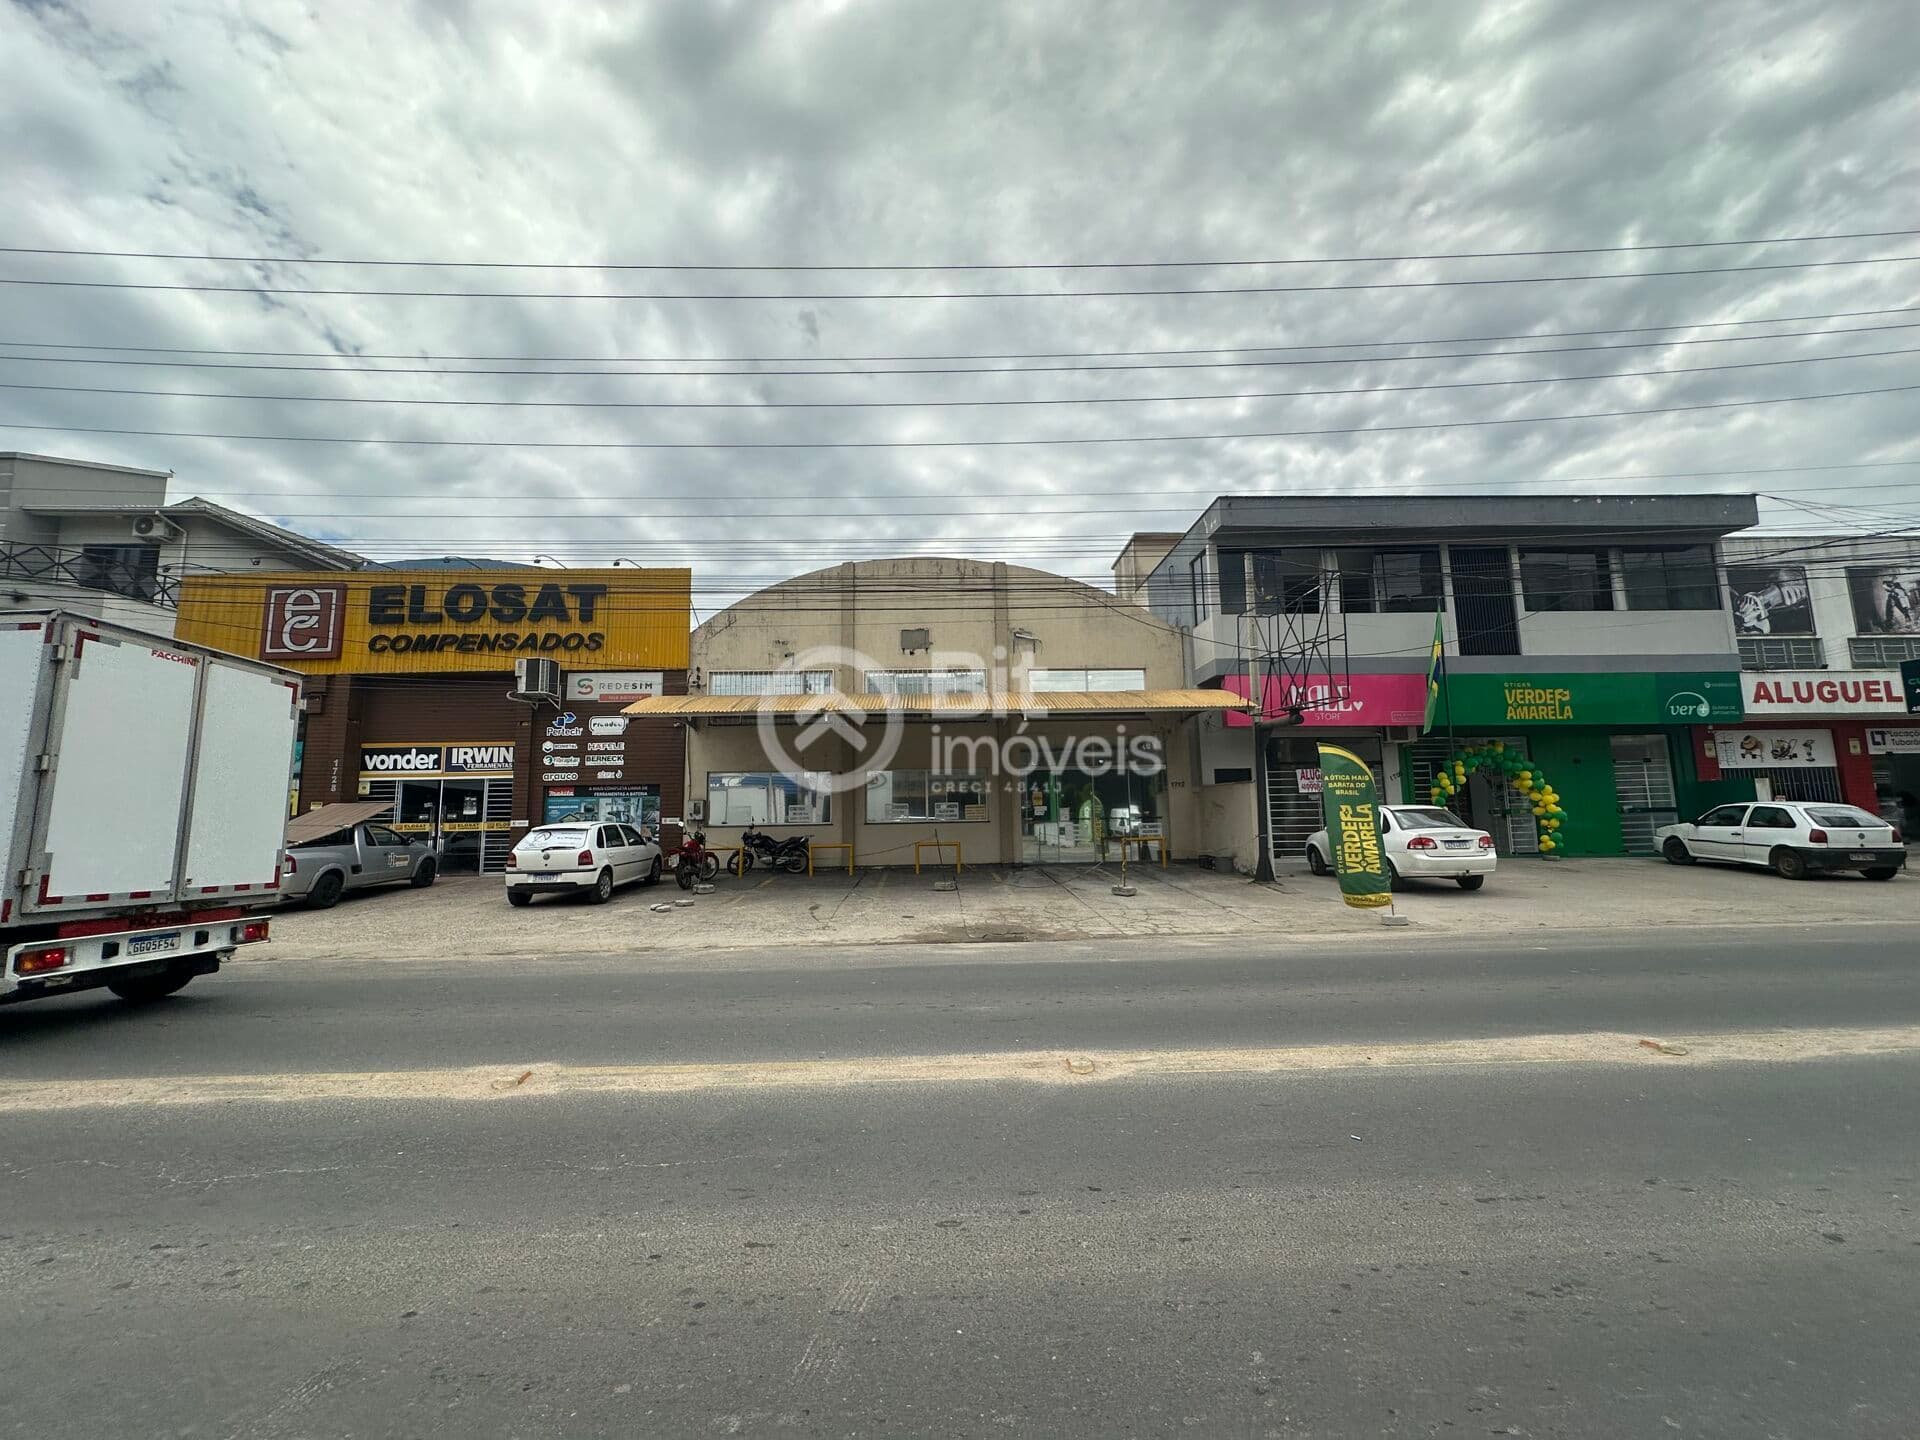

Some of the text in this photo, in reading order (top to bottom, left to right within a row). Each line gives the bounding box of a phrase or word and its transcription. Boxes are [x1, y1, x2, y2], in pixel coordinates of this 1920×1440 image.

[369, 583, 607, 624] ELOSAT
[368, 632, 605, 652] COMPENSADOS
[151, 649, 199, 667] FACCHINI
[599, 682, 653, 690] REDESIM
[1752, 680, 1904, 703] ALUGUEL
[1504, 688, 1555, 704] VERDE
[1506, 705, 1574, 720] AMARELA
[452, 747, 514, 763] IRWIN
[330, 759, 340, 792] 1728
[543, 773, 578, 781] arauco
[1300, 769, 1322, 780] ALUG
[1330, 773, 1350, 781] ÓTICA
[1341, 820, 1363, 874] VERDE
[1356, 803, 1382, 874] AMARELA
